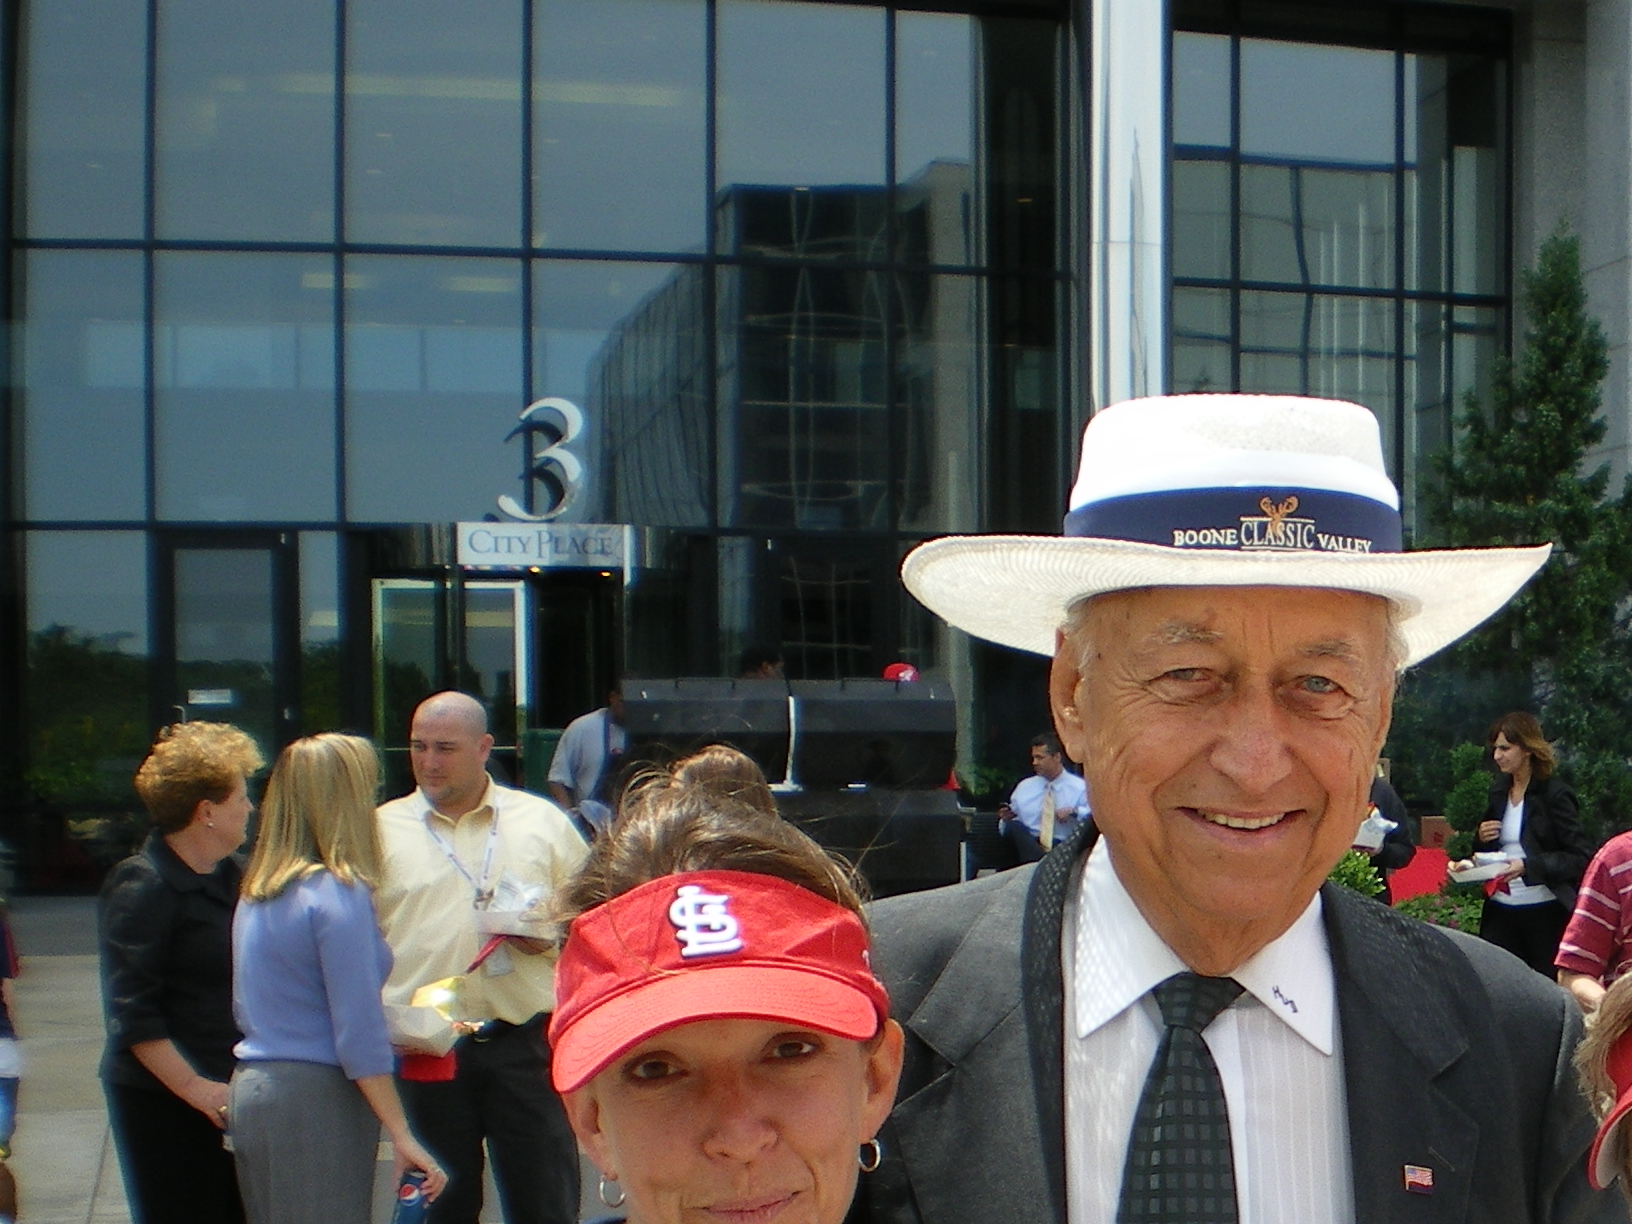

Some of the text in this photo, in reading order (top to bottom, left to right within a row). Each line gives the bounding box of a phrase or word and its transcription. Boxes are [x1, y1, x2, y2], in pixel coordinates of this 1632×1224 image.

[498, 397, 583, 522] 3
[1173, 521, 1372, 554] BOONE CLASSIC VALLEY
